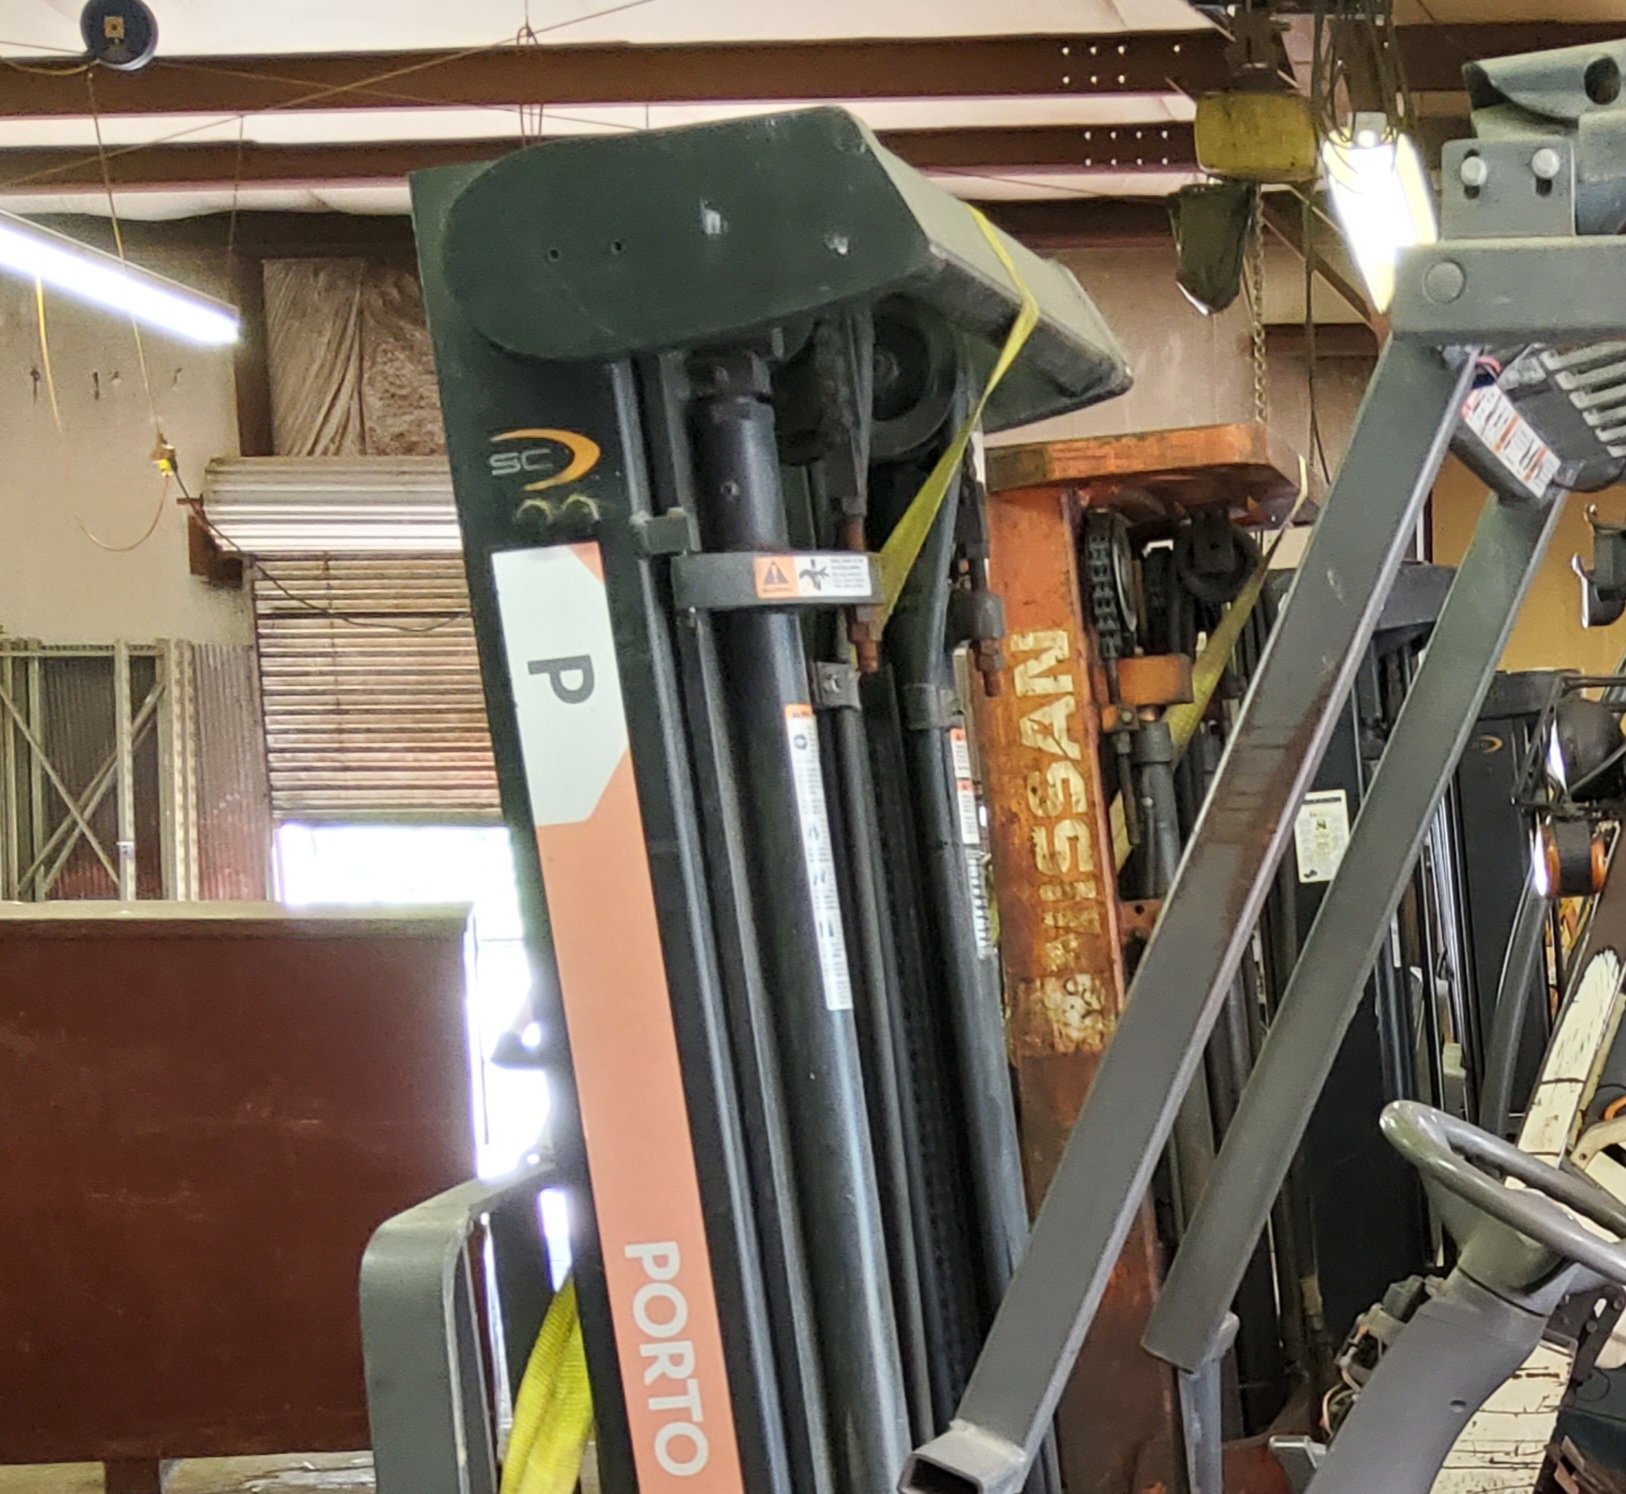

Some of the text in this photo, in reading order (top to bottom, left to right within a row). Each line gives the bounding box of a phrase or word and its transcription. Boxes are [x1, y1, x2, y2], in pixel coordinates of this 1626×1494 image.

[490, 448, 552, 476] SC
[527, 654, 595, 705] P
[1010, 630, 1102, 971] NISSAN
[624, 1241, 708, 1477] PORTO
